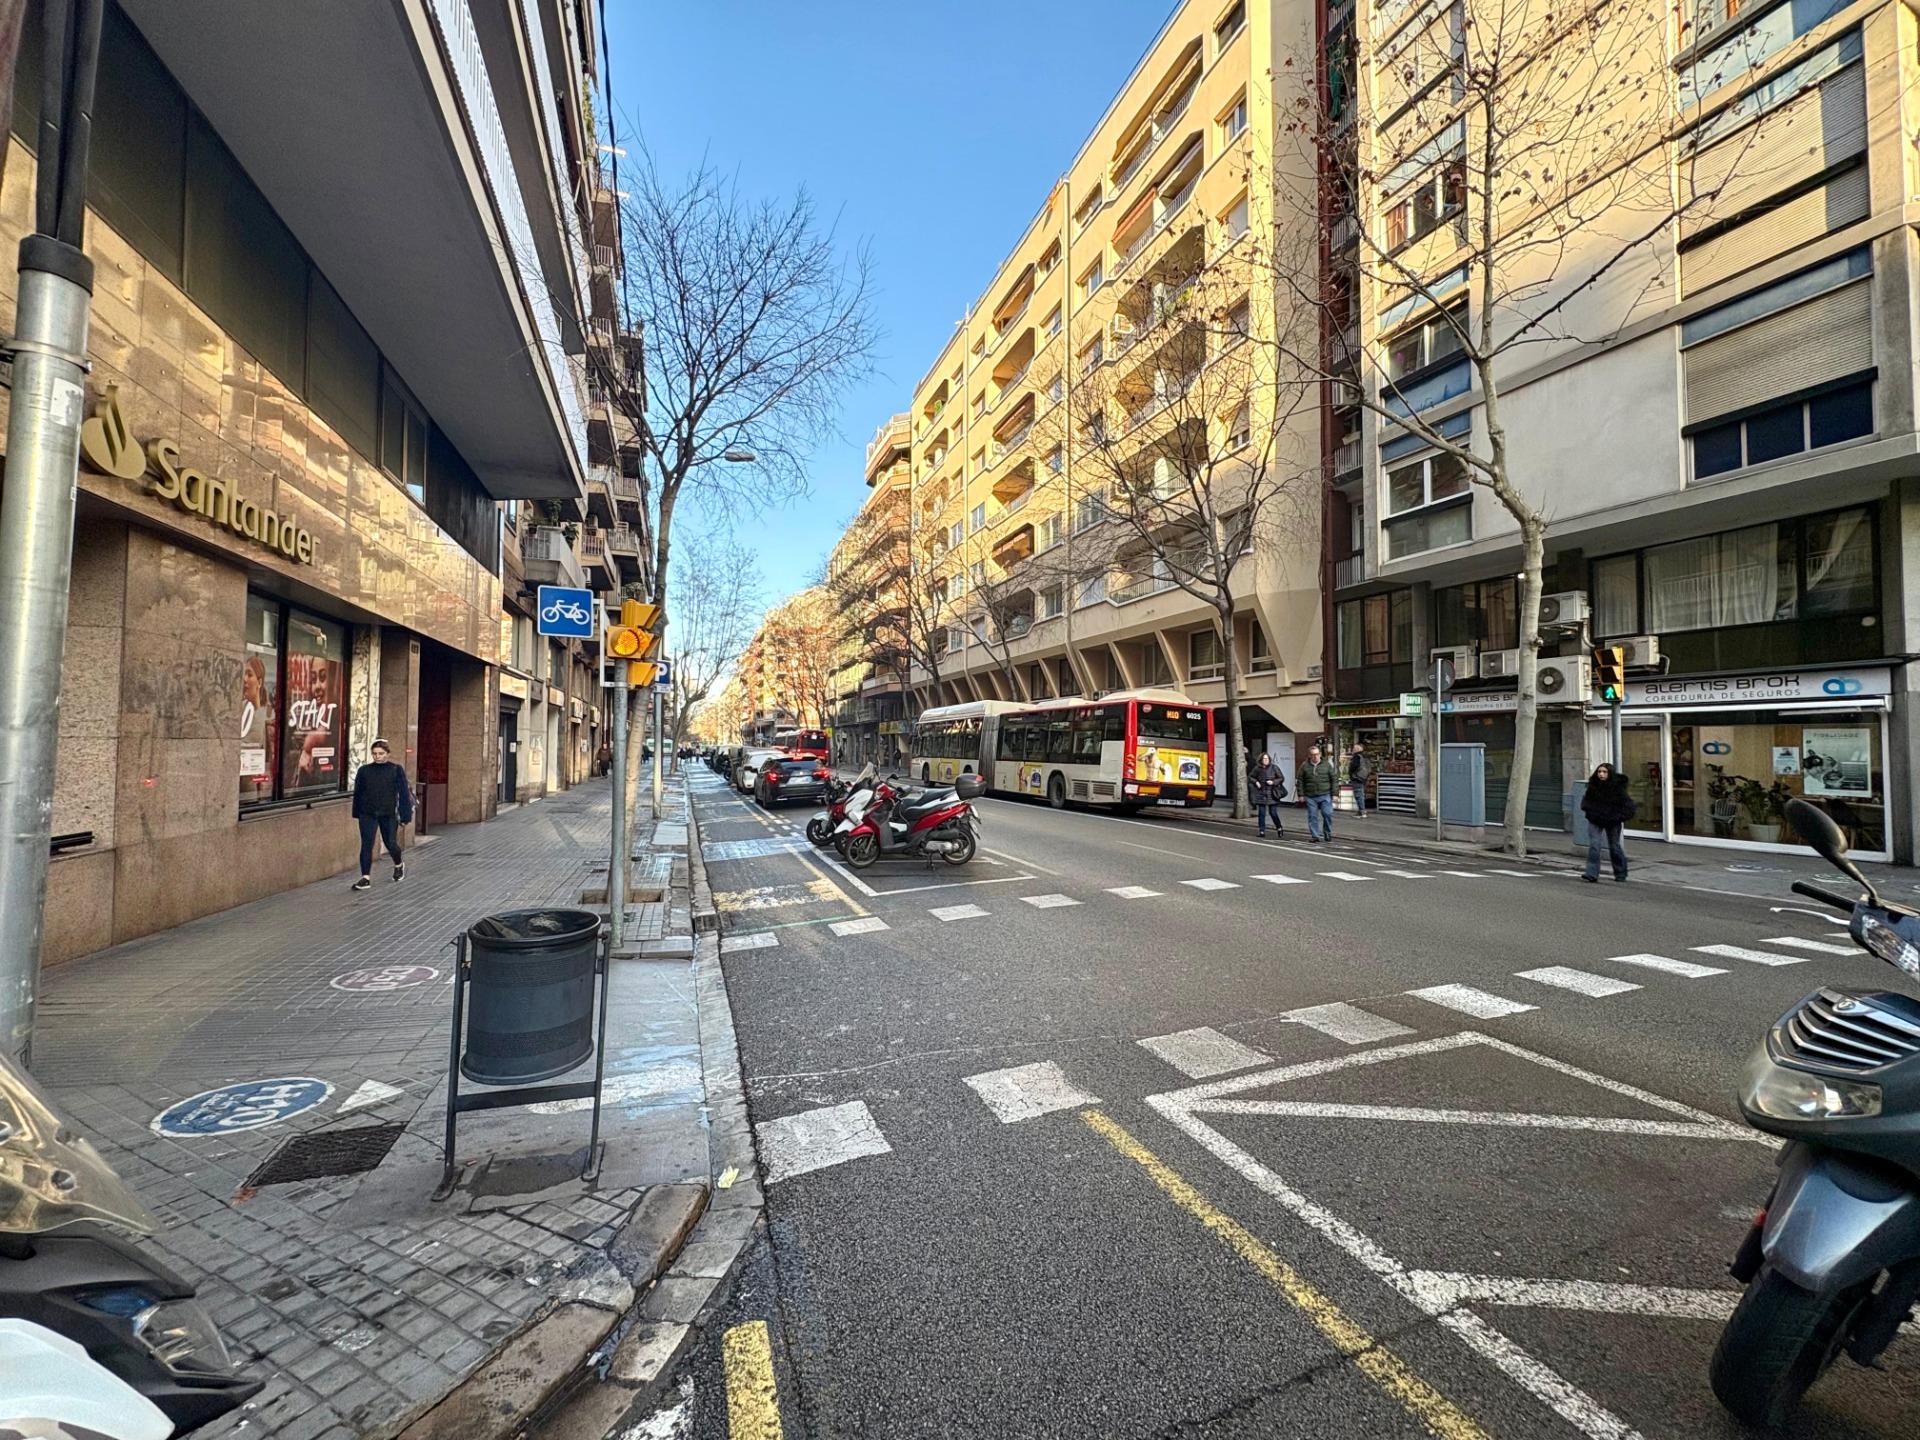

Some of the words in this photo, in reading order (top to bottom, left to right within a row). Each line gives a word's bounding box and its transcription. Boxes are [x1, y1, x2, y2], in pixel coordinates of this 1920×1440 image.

[150, 437, 321, 566] Santander
[655, 662, 668, 681] P
[1644, 693, 1715, 703] CORREDURIA
[1721, 691, 1735, 700] DE
[1742, 688, 1801, 699] SEGUROS
[288, 698, 338, 730] START
[1186, 712, 1202, 720] 6025
[1336, 706, 1400, 717] SUPERMERCA
[217, 1082, 313, 1127] H10
